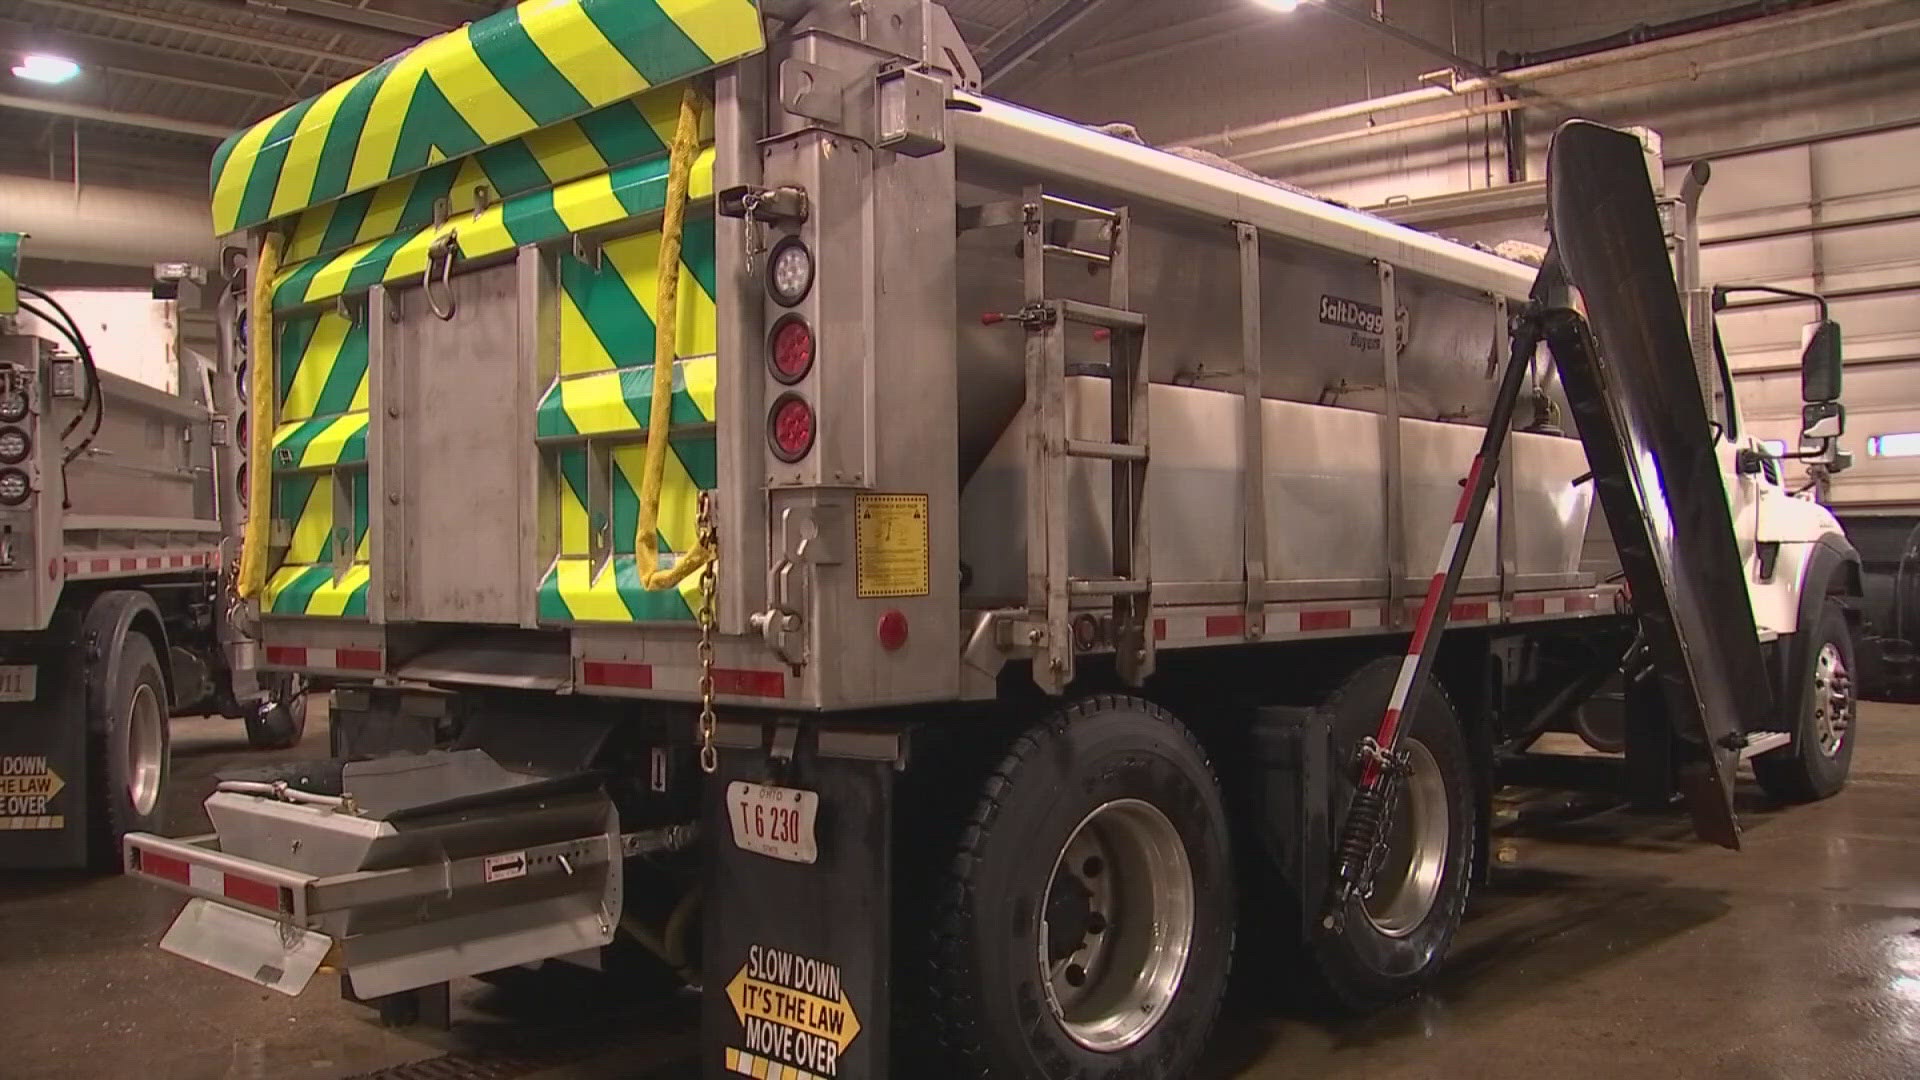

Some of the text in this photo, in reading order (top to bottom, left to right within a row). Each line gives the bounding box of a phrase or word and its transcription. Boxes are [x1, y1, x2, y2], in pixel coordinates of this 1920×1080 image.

[3, 756, 47, 775] DOWN
[20, 779, 51, 793] LAW
[759, 788, 783, 801] OHIO
[8, 796, 46, 815] OVER
[740, 801, 799, 844] T 6 230
[749, 944, 841, 1001] SLOW DOWN
[743, 983, 844, 1036] IT'S THE LAW
[746, 1017, 837, 1077] MOVE OVER
